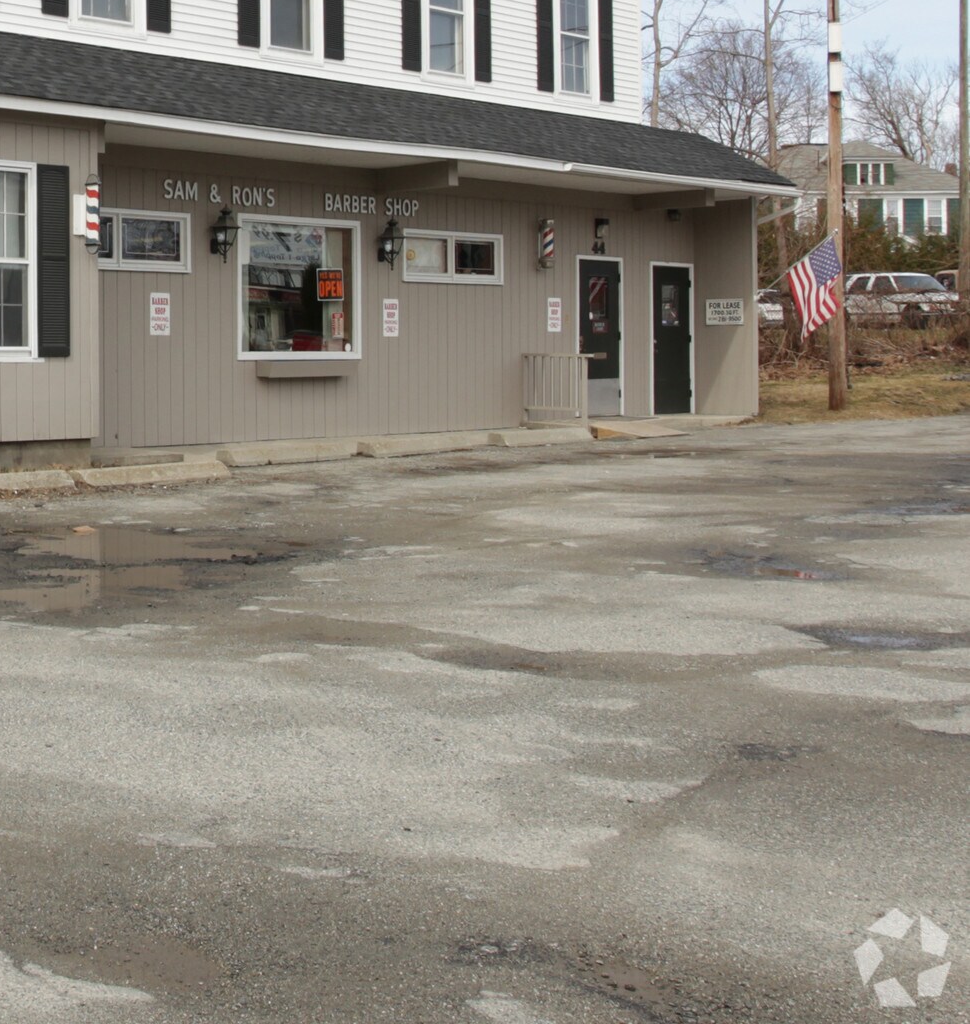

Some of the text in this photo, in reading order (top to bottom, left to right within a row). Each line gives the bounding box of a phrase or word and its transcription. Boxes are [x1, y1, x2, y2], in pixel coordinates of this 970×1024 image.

[163, 179, 419, 216] SAM & RON'S BARBER SHOP
[592, 241, 606, 254] 44
[318, 280, 343, 297] OPEN
[722, 301, 741, 309] LEASE
